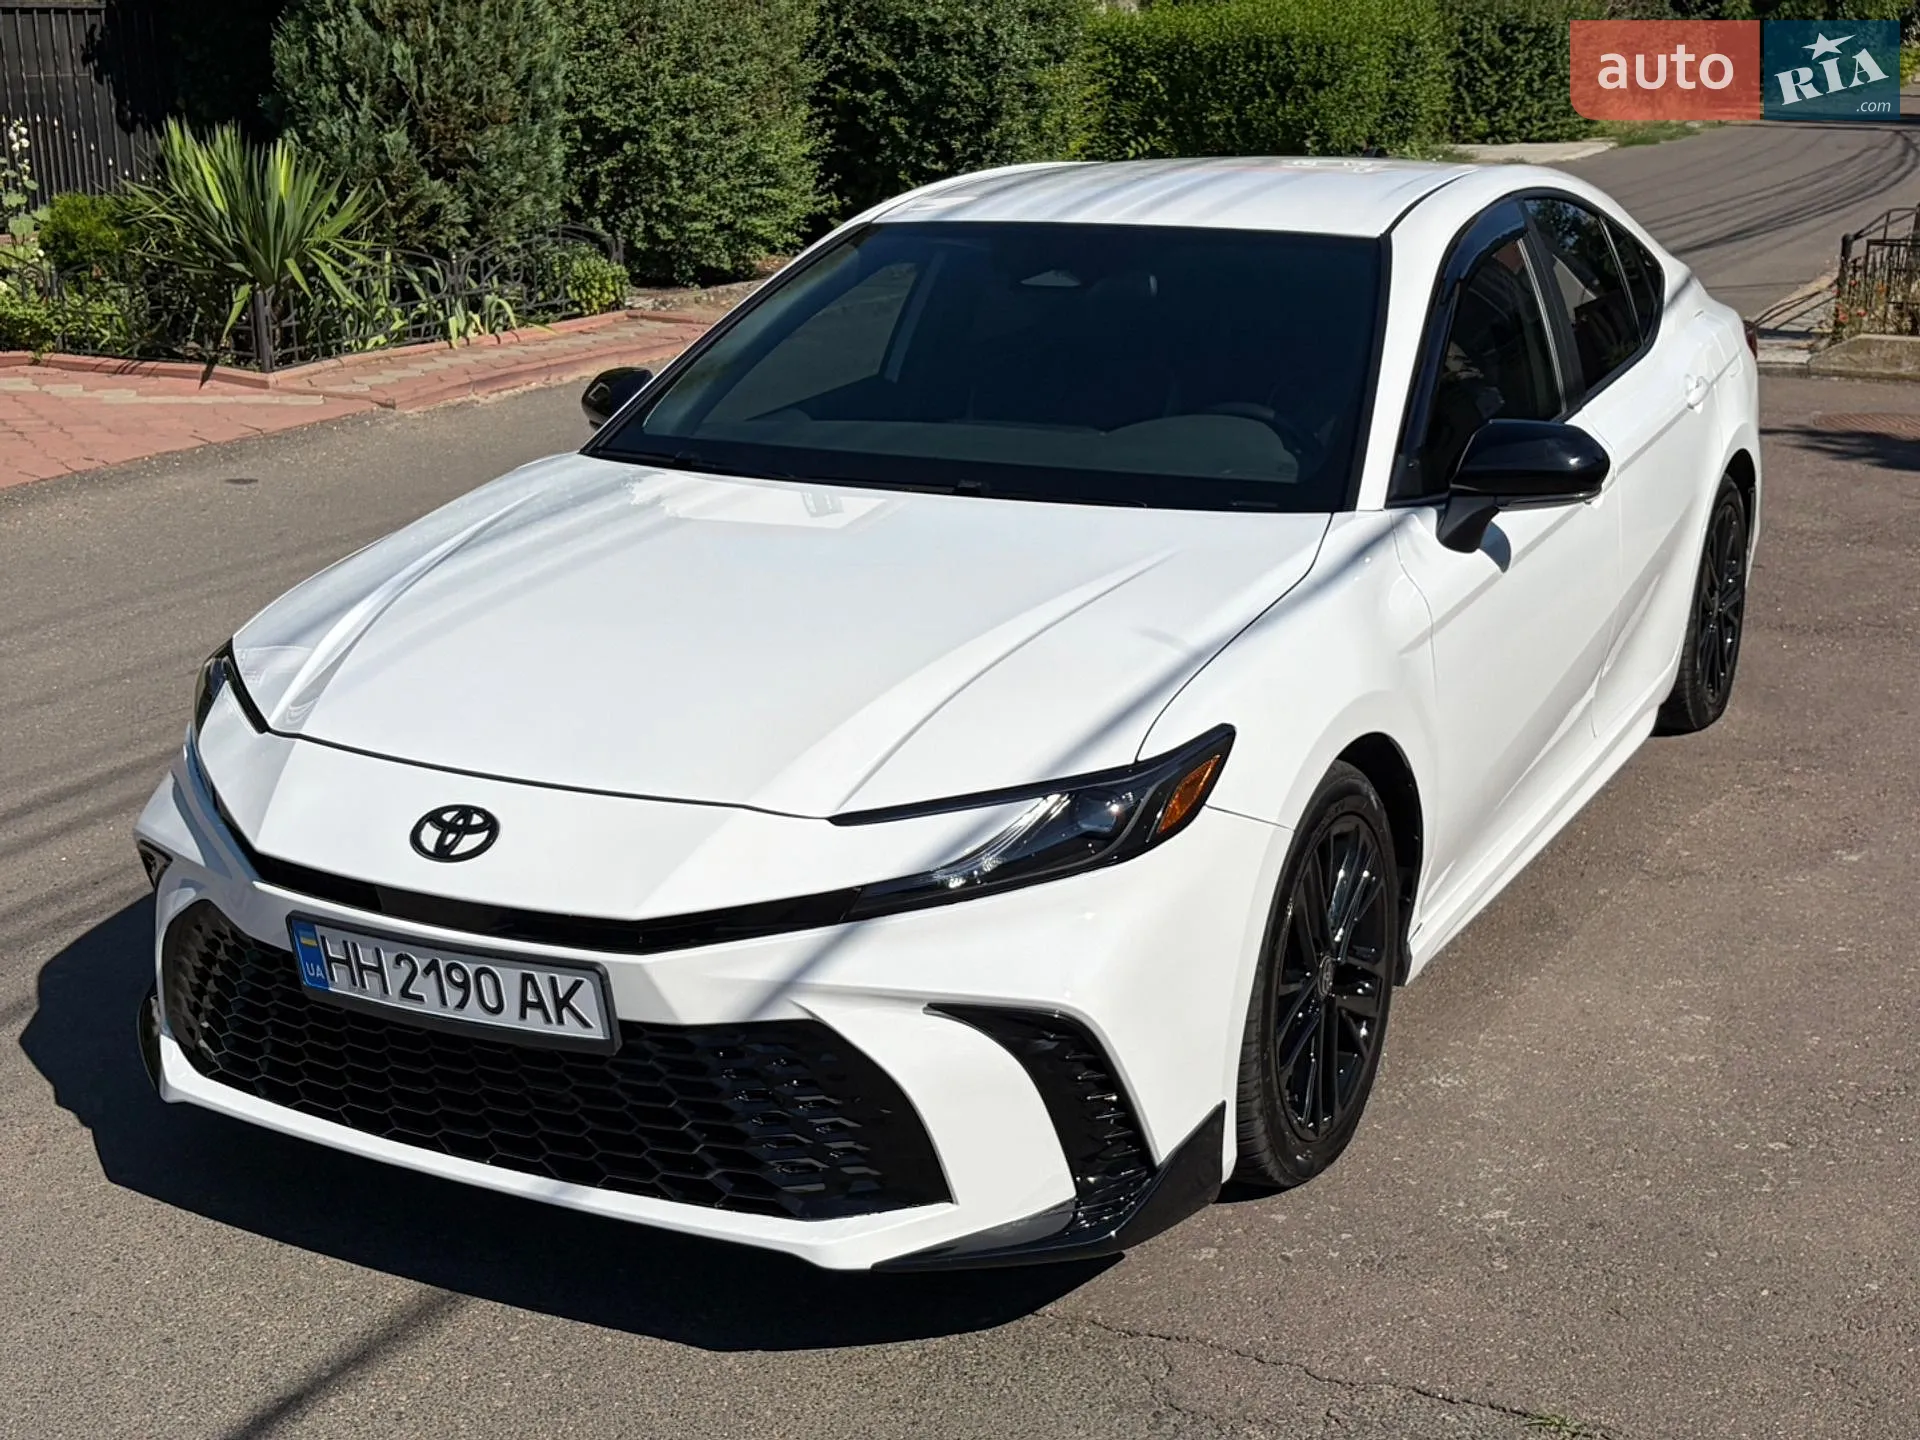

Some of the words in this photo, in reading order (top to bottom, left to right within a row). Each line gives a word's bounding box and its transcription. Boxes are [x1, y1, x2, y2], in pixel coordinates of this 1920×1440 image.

[305, 961, 325, 979] UA
[321, 935, 392, 996] HH
[395, 952, 506, 1015] 2190
[519, 971, 594, 1029] AK
